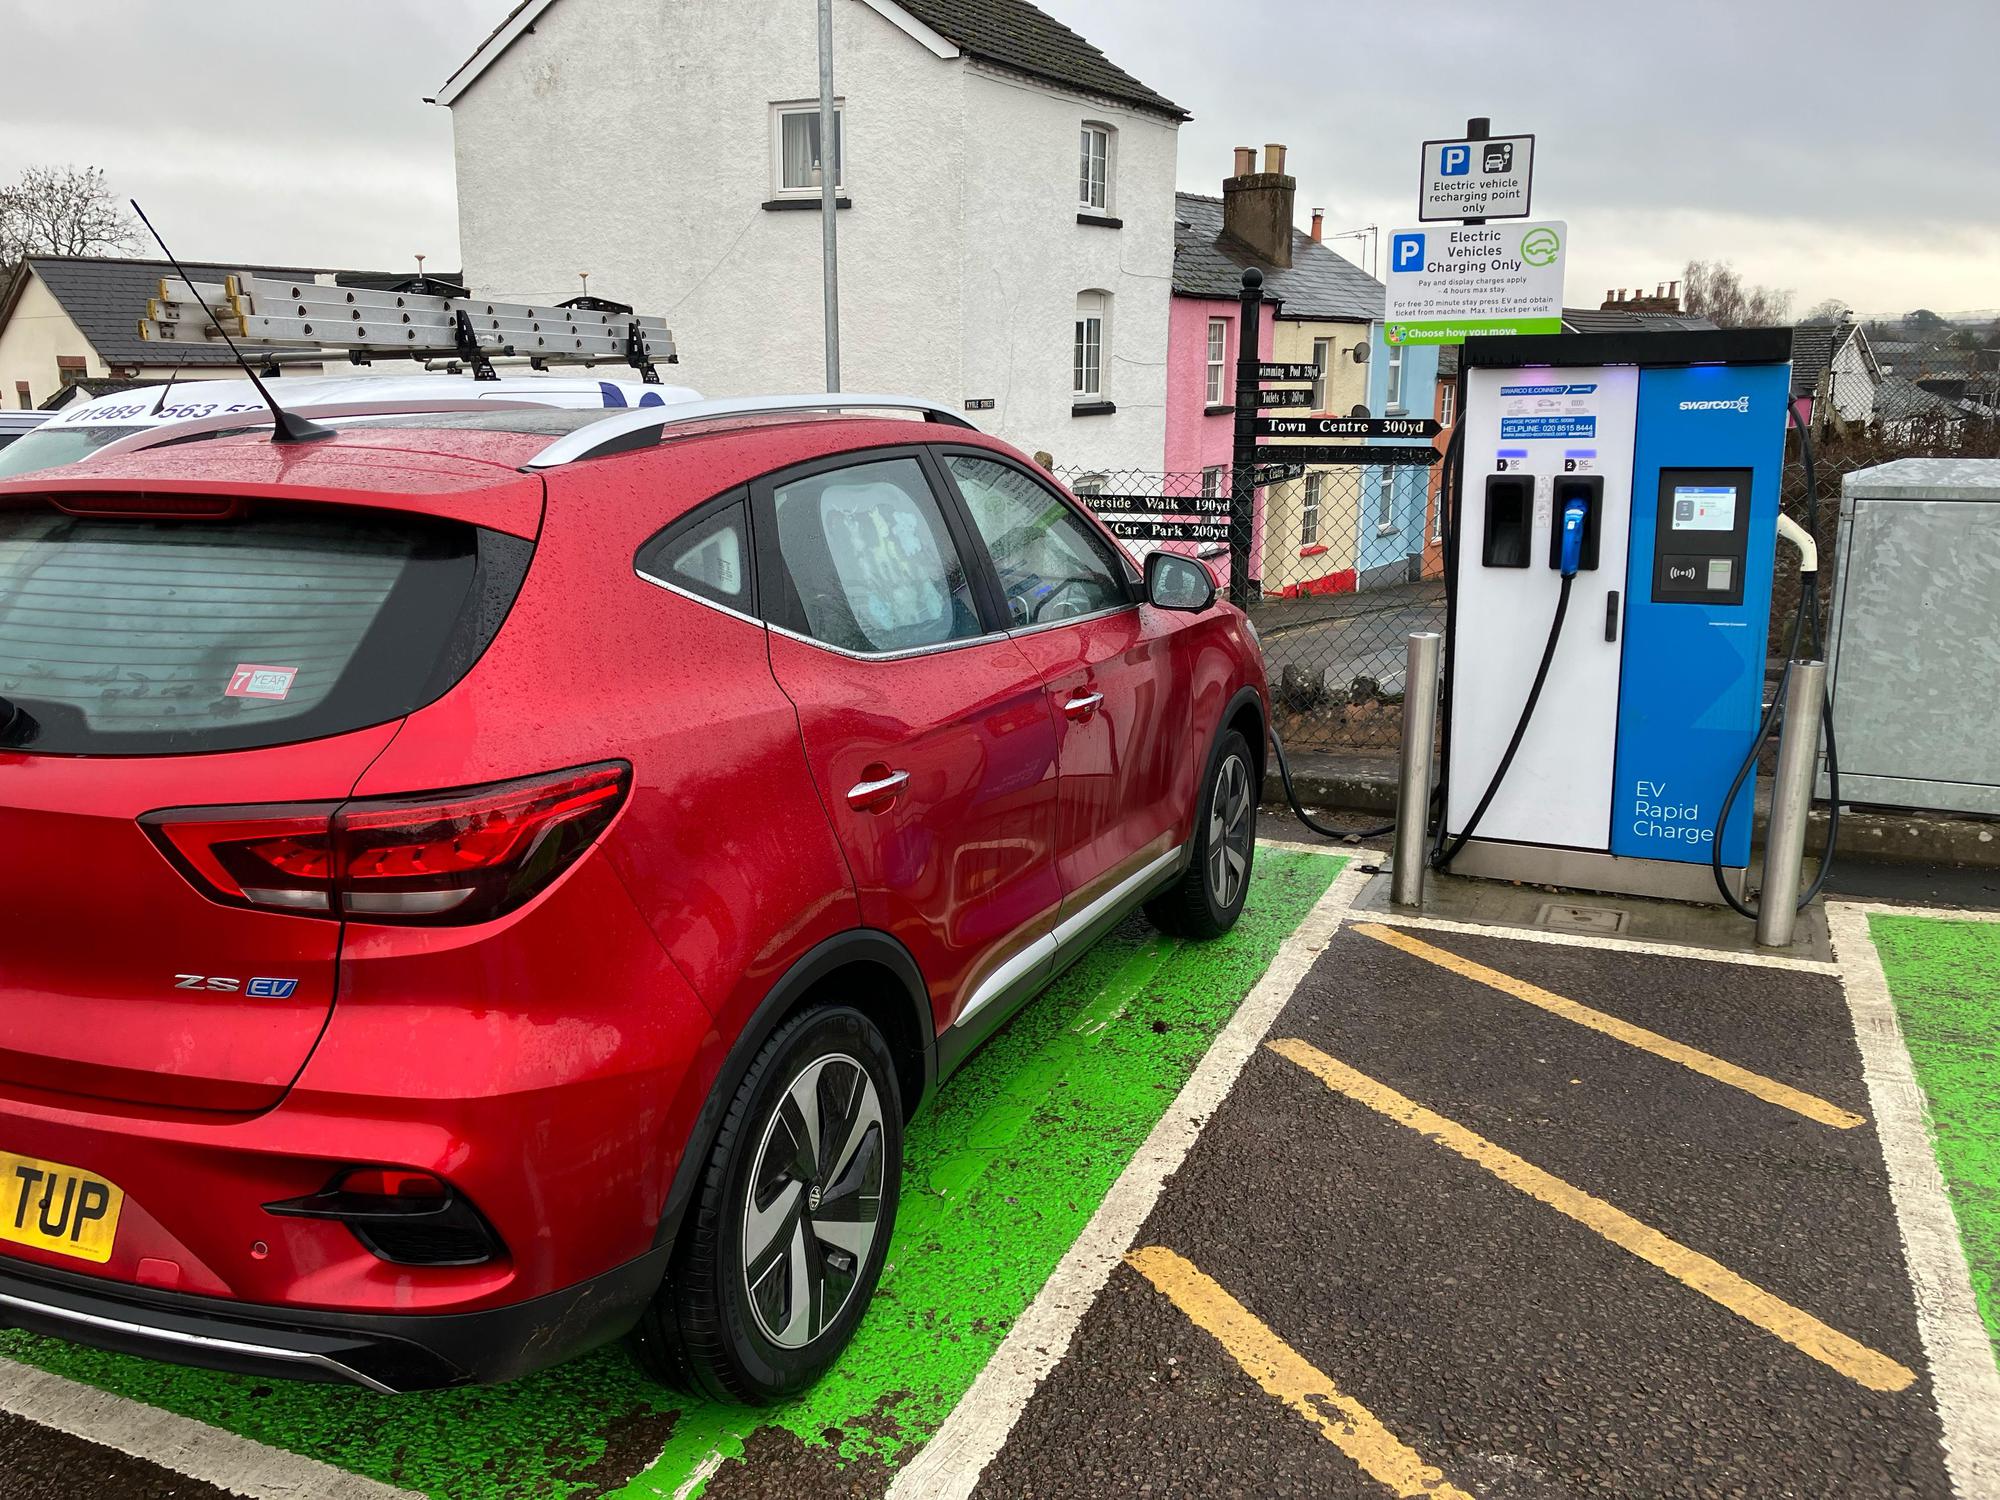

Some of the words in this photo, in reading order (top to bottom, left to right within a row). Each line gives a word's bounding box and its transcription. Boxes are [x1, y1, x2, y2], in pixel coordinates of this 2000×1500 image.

[1446, 149, 1464, 173] P
[1434, 180, 1475, 190] Electric
[1480, 178, 1518, 188] vehicle
[1430, 191, 1487, 202] recharging
[1492, 189, 1520, 200] point
[1462, 203, 1486, 213] only
[1450, 230, 1502, 242] Electric
[1401, 241, 1420, 266] P
[1448, 246, 1502, 257] Vehicles
[1428, 261, 1486, 274] Charging
[1491, 259, 1522, 271] Only
[1476, 277, 1504, 285] charges
[1408, 329, 1445, 338] Choose
[1446, 328, 1467, 336] how
[1263, 392, 1280, 403] Toilets
[1680, 400, 1730, 410] swarco
[65, 404, 146, 422] 01989
[158, 404, 218, 418] 563
[1268, 420, 1306, 432] Town
[1319, 420, 1368, 432] Centre
[1382, 421, 1424, 436] 300yd
[1145, 498, 1178, 510] Walk
[1195, 500, 1230, 512] 190yd
[1152, 525, 1183, 536] Park
[1192, 525, 1228, 540] 200yd
[233, 672, 251, 689] 7
[255, 675, 286, 685] YEAR
[1637, 780, 1666, 798] EV
[1635, 801, 1698, 822] Rapid
[1633, 820, 1714, 844] Charge
[174, 974, 240, 992] ZS
[251, 980, 294, 996] EV
[14, 1166, 110, 1242] TUP
